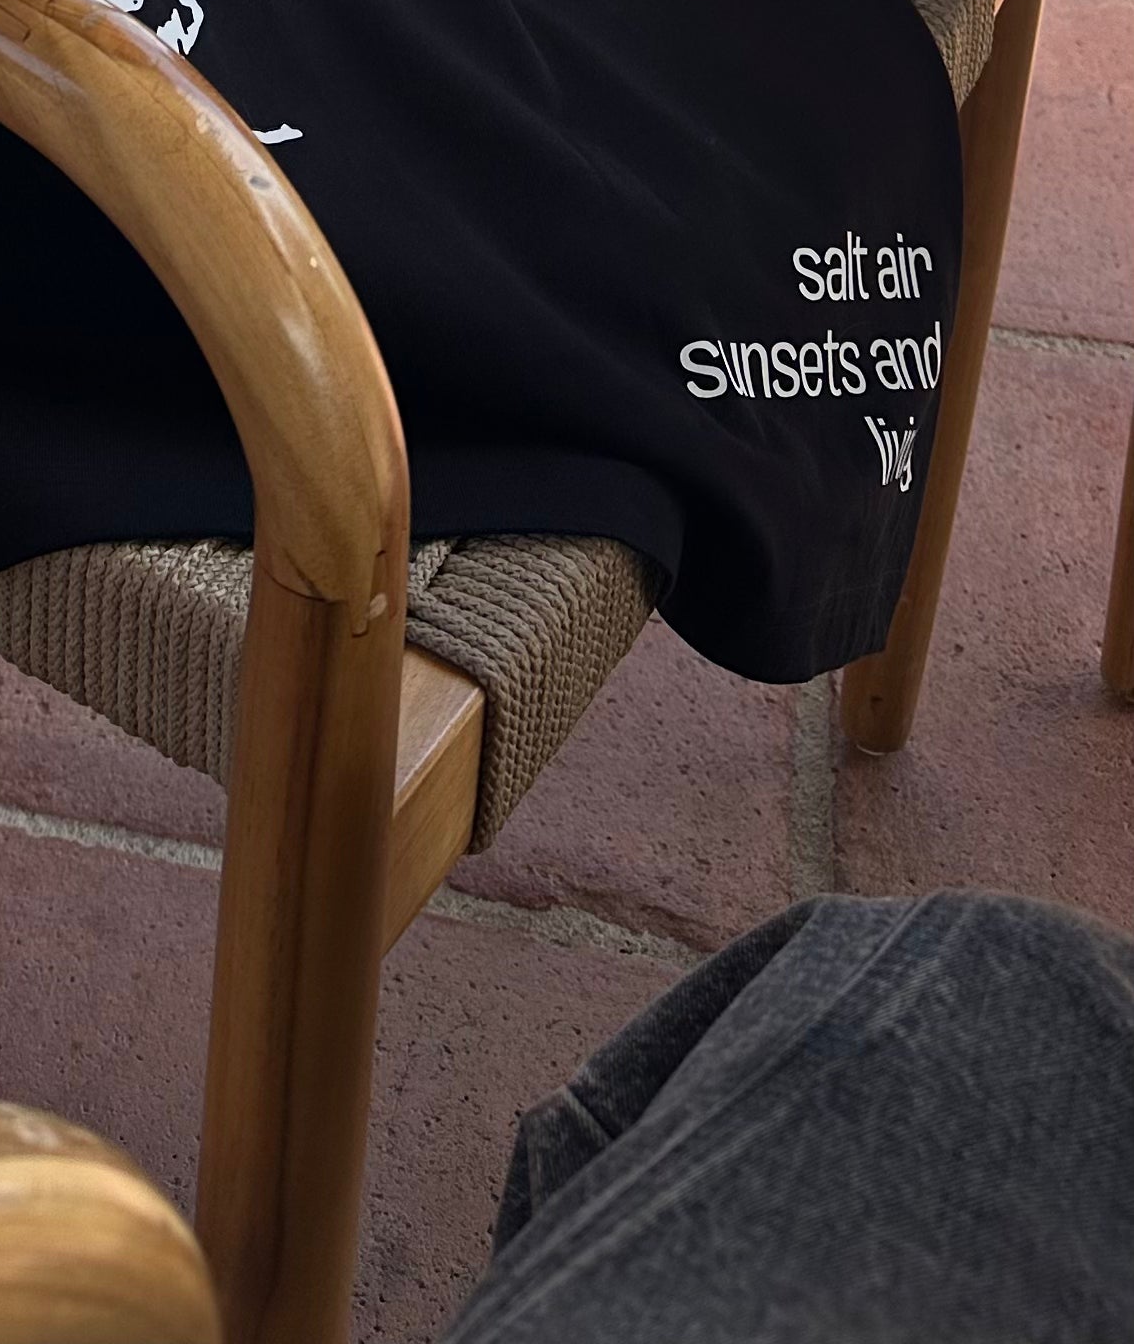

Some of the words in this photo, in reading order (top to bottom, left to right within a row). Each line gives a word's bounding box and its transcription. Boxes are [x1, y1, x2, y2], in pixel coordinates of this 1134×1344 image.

[792, 230, 870, 302] salt
[876, 232, 933, 300] air
[869, 320, 942, 391] and
